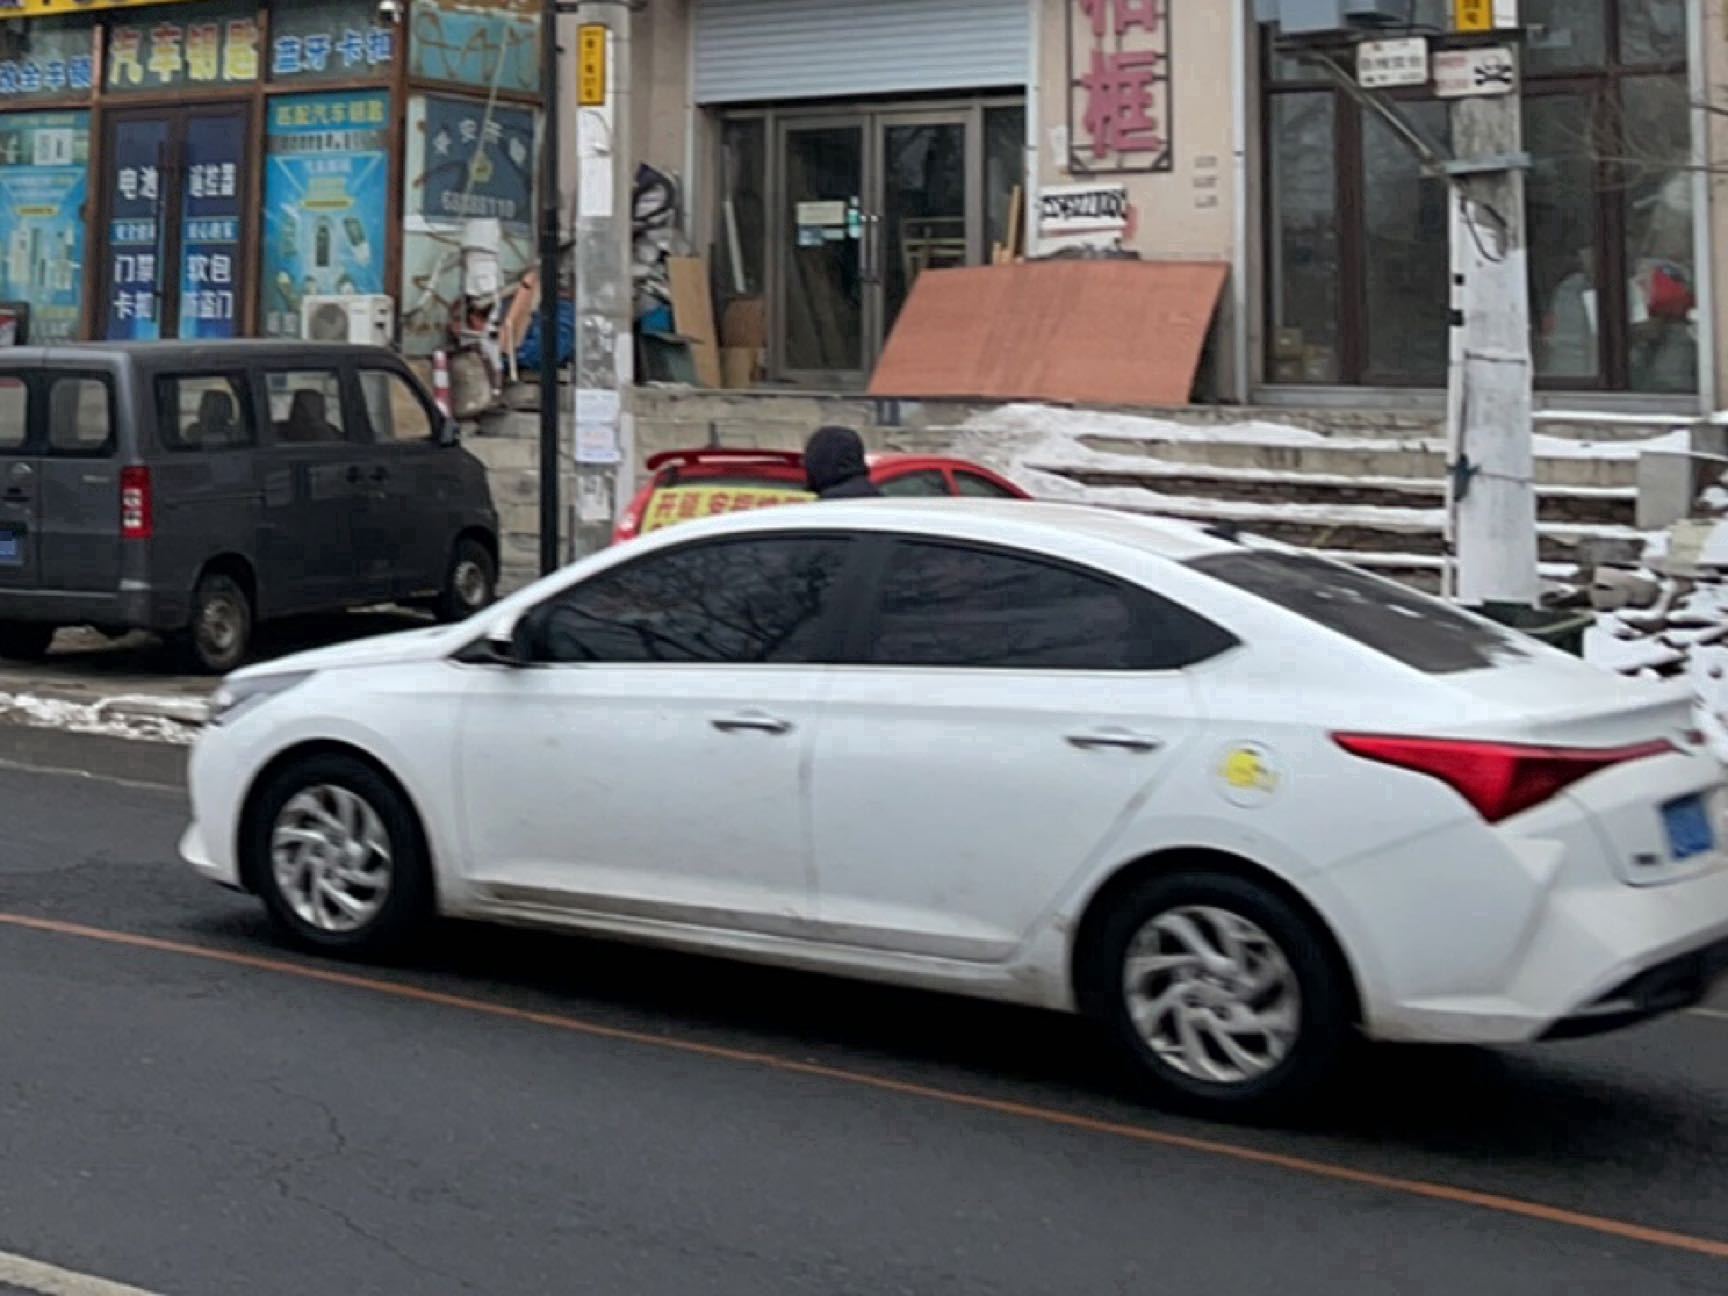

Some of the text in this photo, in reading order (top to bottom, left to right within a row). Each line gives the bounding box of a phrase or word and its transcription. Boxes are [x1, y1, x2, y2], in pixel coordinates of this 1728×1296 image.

[109, 19, 260, 86] 汽车钥匙
[118, 166, 159, 200] 电池
